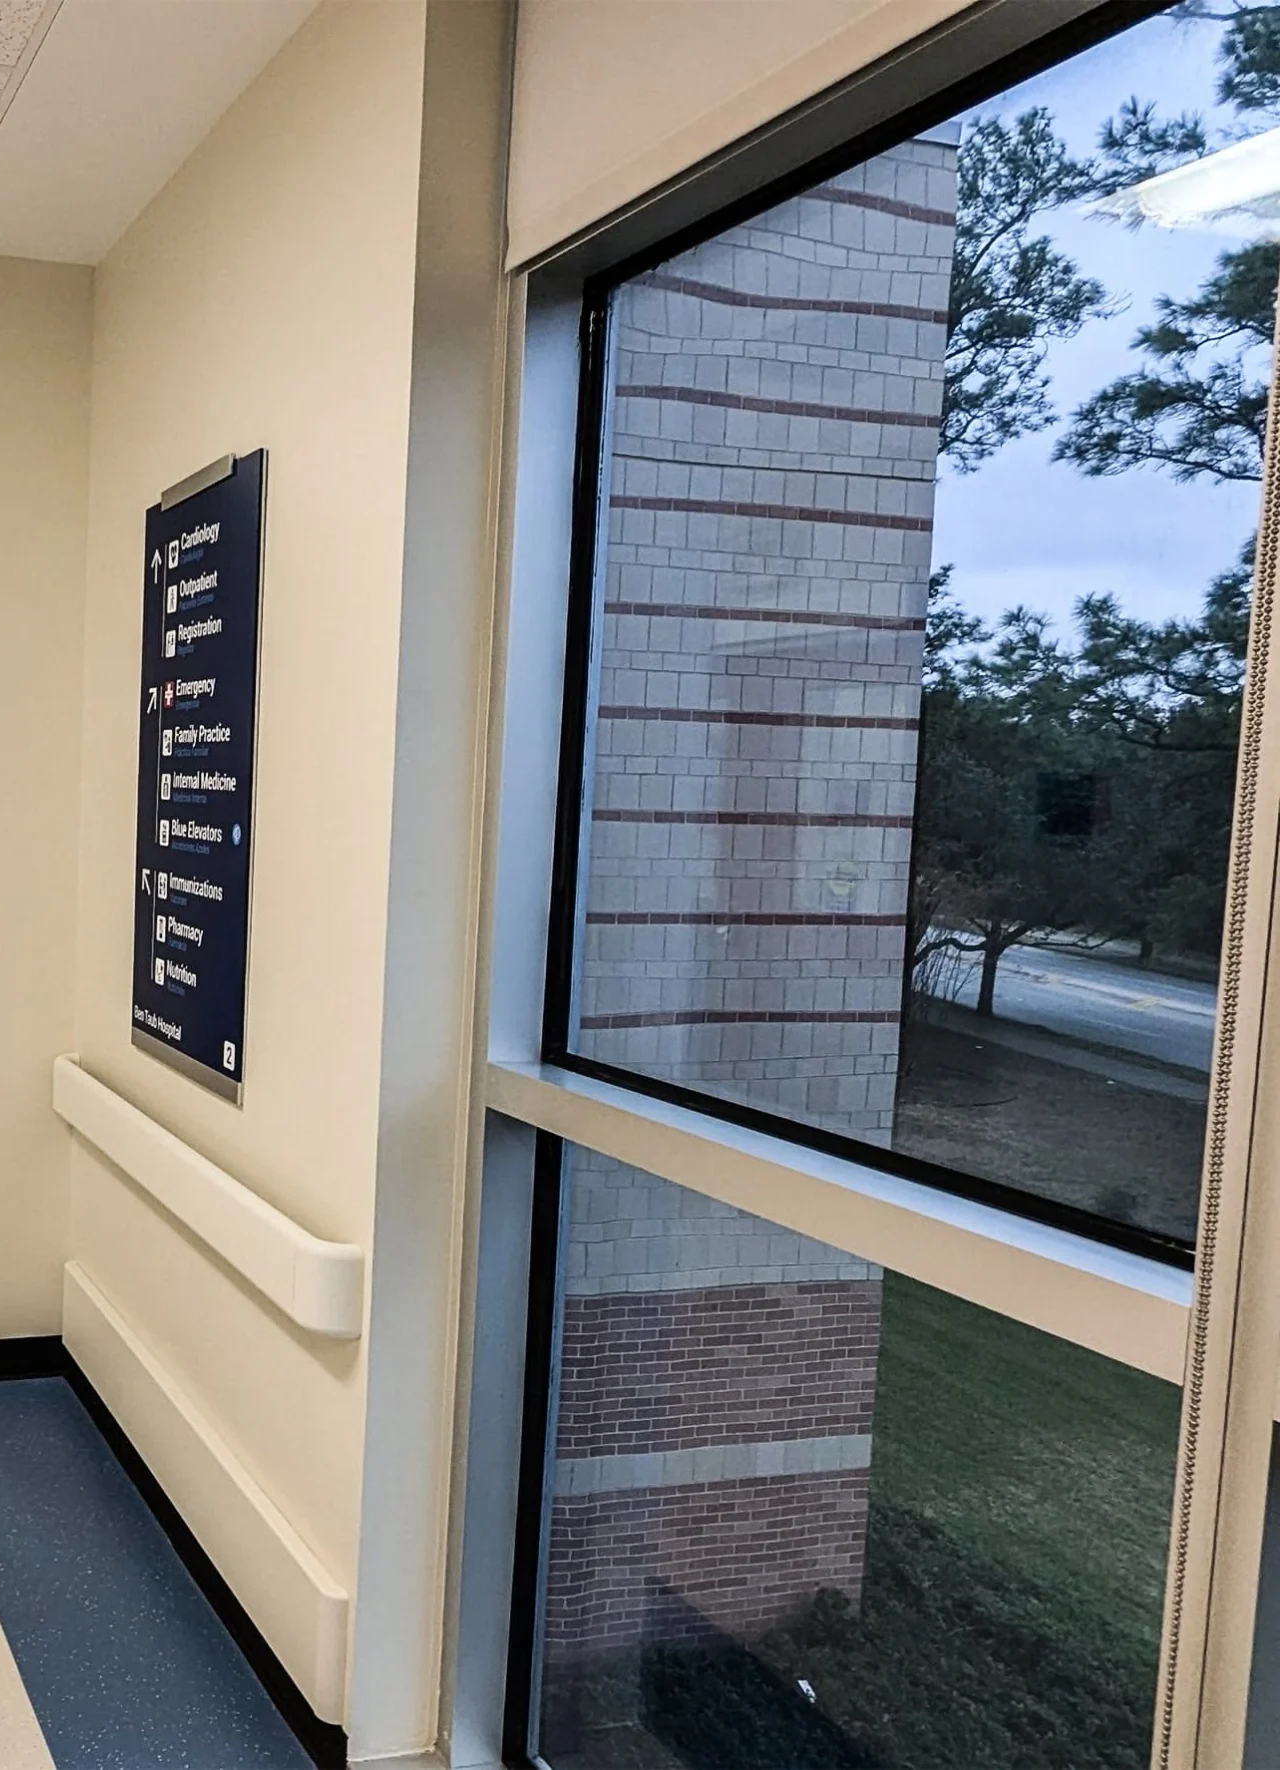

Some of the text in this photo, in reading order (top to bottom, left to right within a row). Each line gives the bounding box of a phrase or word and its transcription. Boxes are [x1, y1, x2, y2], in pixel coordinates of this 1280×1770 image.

[181, 521, 220, 550] Cardiology
[179, 569, 218, 598] Outpatient
[178, 615, 222, 644] Registration
[176, 678, 216, 699] Emergency
[174, 722, 231, 747] Family Practice
[172, 770, 236, 792] Internal Medicine
[171, 818, 222, 842] Blue Elevators
[169, 872, 223, 901] Immunizations
[168, 915, 204, 947] Pharmacy
[166, 960, 197, 988] Nutrition
[134, 1004, 182, 1041] Ben Taub Hospital
[226, 1046, 232, 1065] 2
